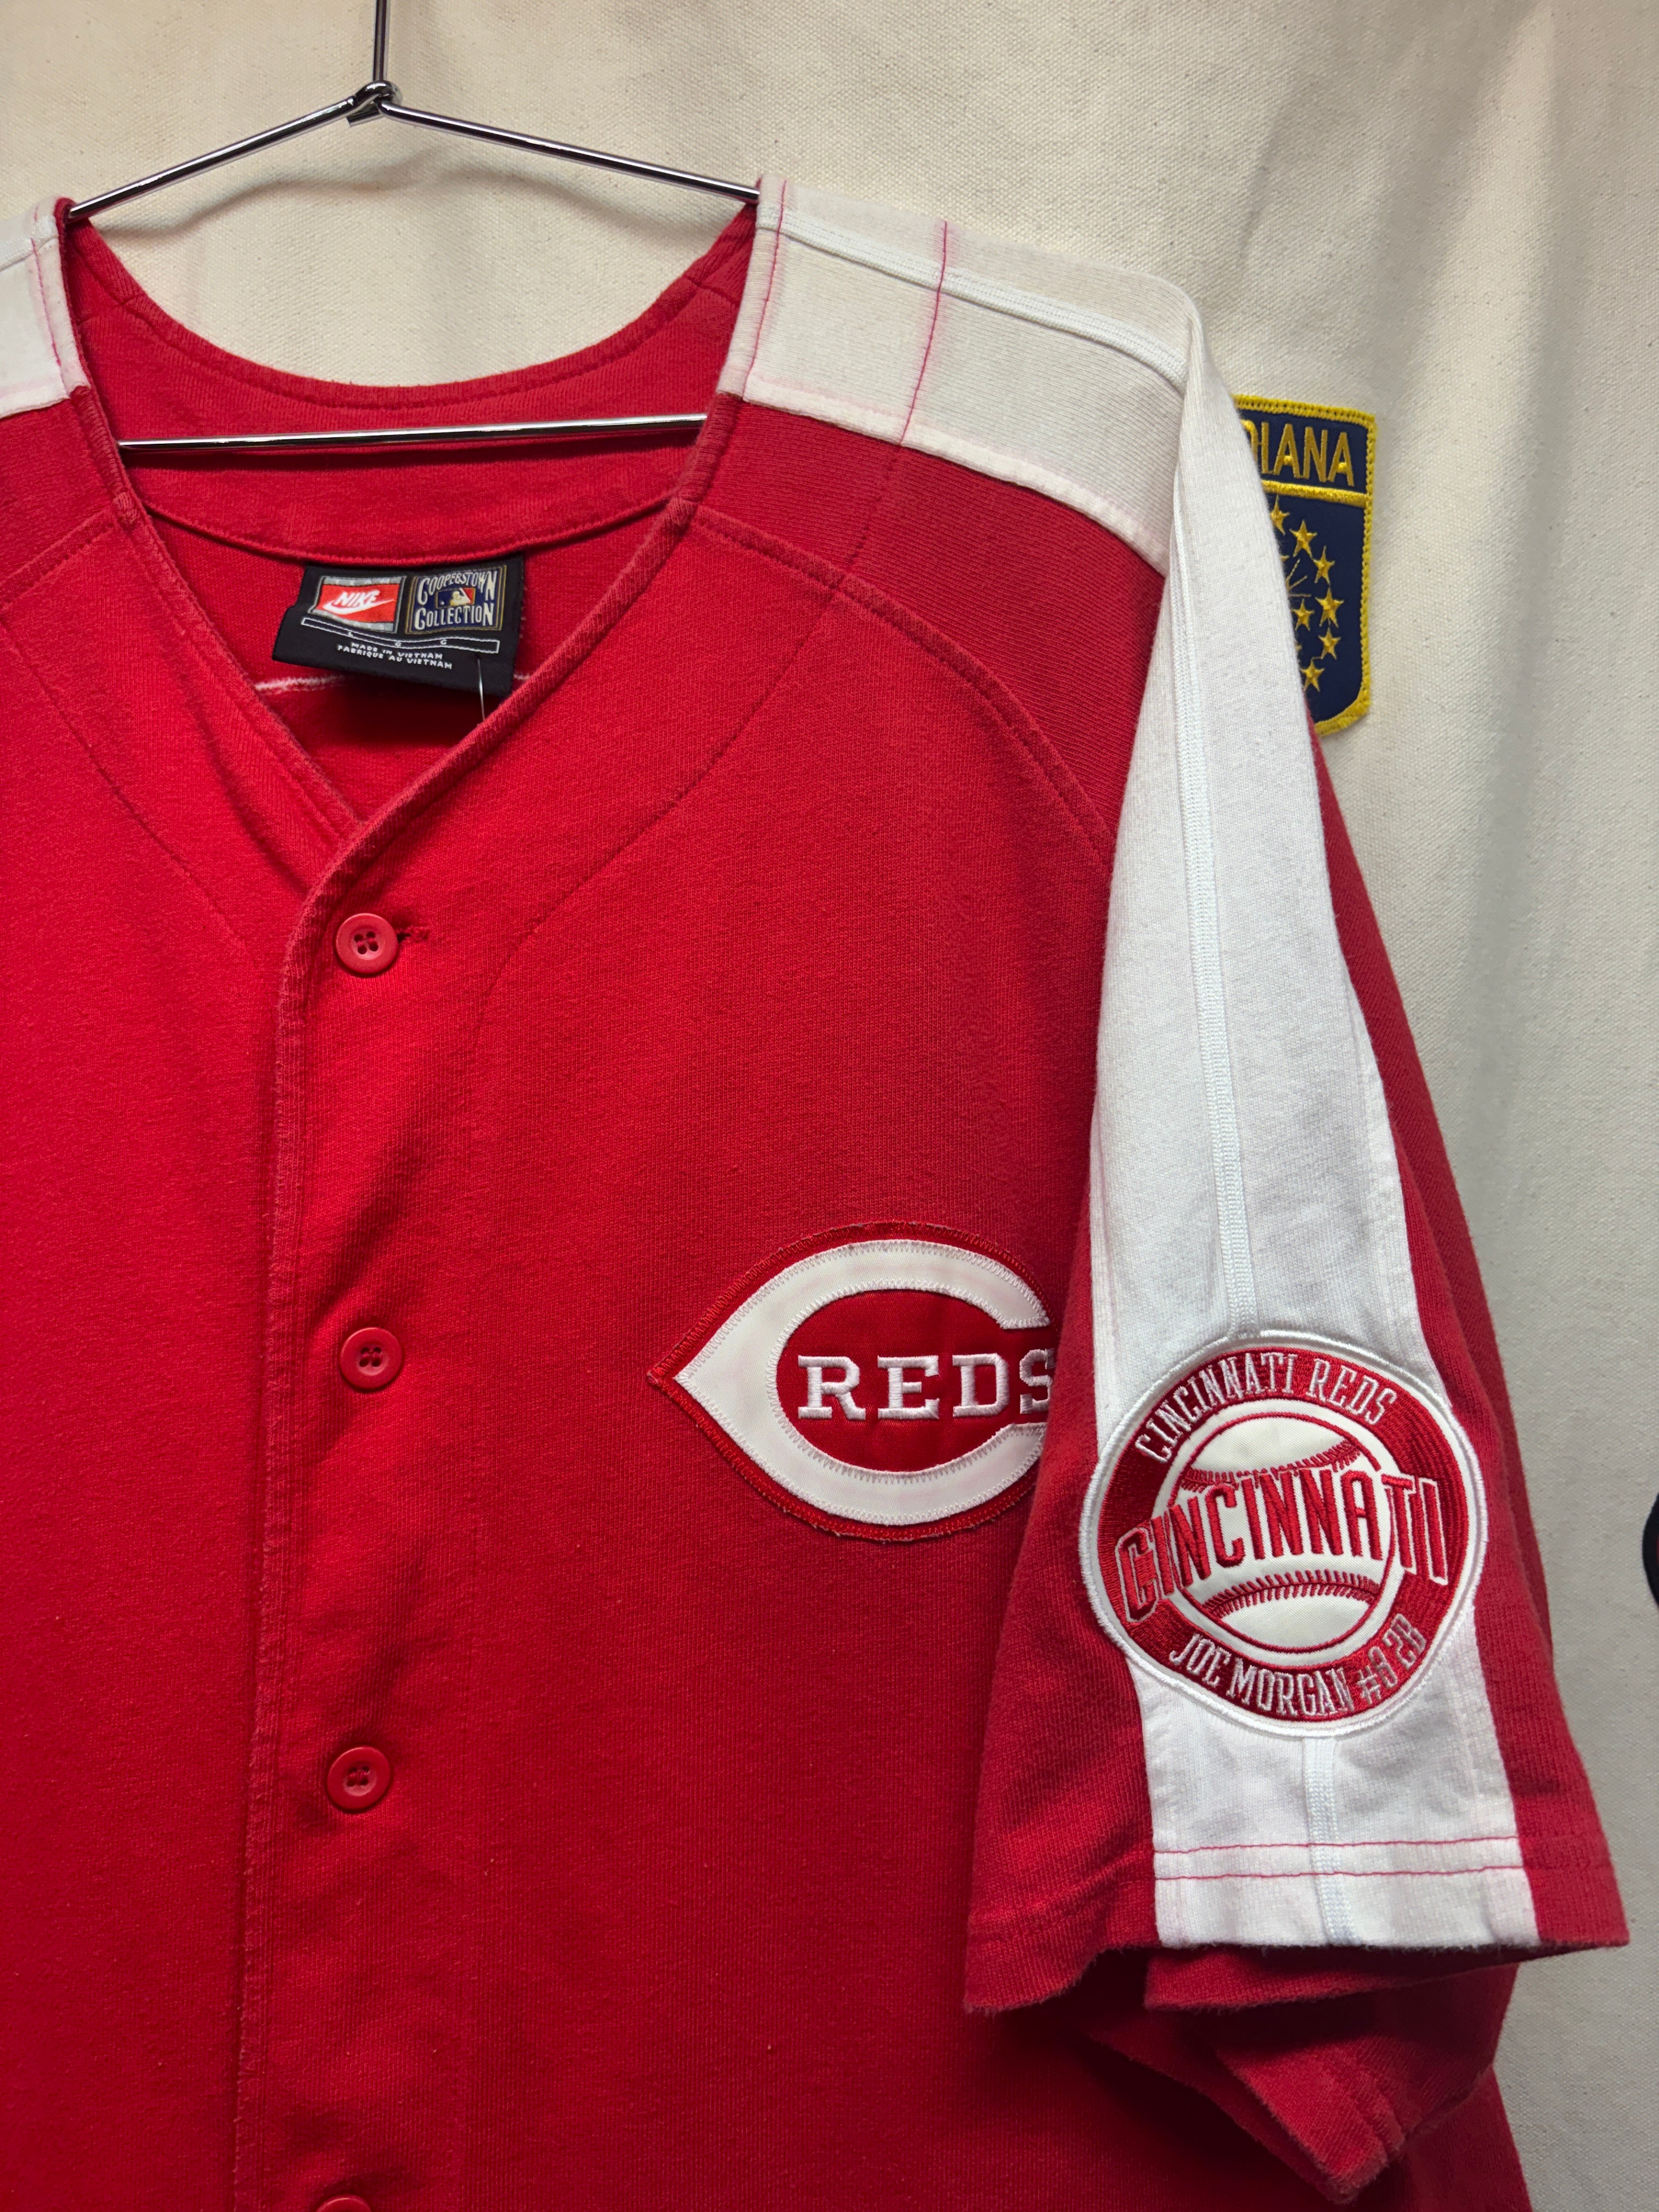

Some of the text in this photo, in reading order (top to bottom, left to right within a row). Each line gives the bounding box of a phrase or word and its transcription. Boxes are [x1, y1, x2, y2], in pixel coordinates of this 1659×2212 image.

[333, 590, 380, 607] NIKE
[417, 571, 498, 605] COOPERSTOWN
[414, 602, 494, 630] COLLECTION
[337, 645, 384, 659] FABRIQUE
[407, 658, 453, 670] VIETNAM
[351, 642, 378, 652] MADE
[398, 652, 443, 660] VIETNAM
[797, 1347, 1055, 1420] REDS
[1135, 1352, 1397, 1464] CINCINNATI REDS
[1115, 1469, 1449, 1622] CINCINNATI
[1169, 1613, 1426, 1717] JOE MORGAN #8 2B
